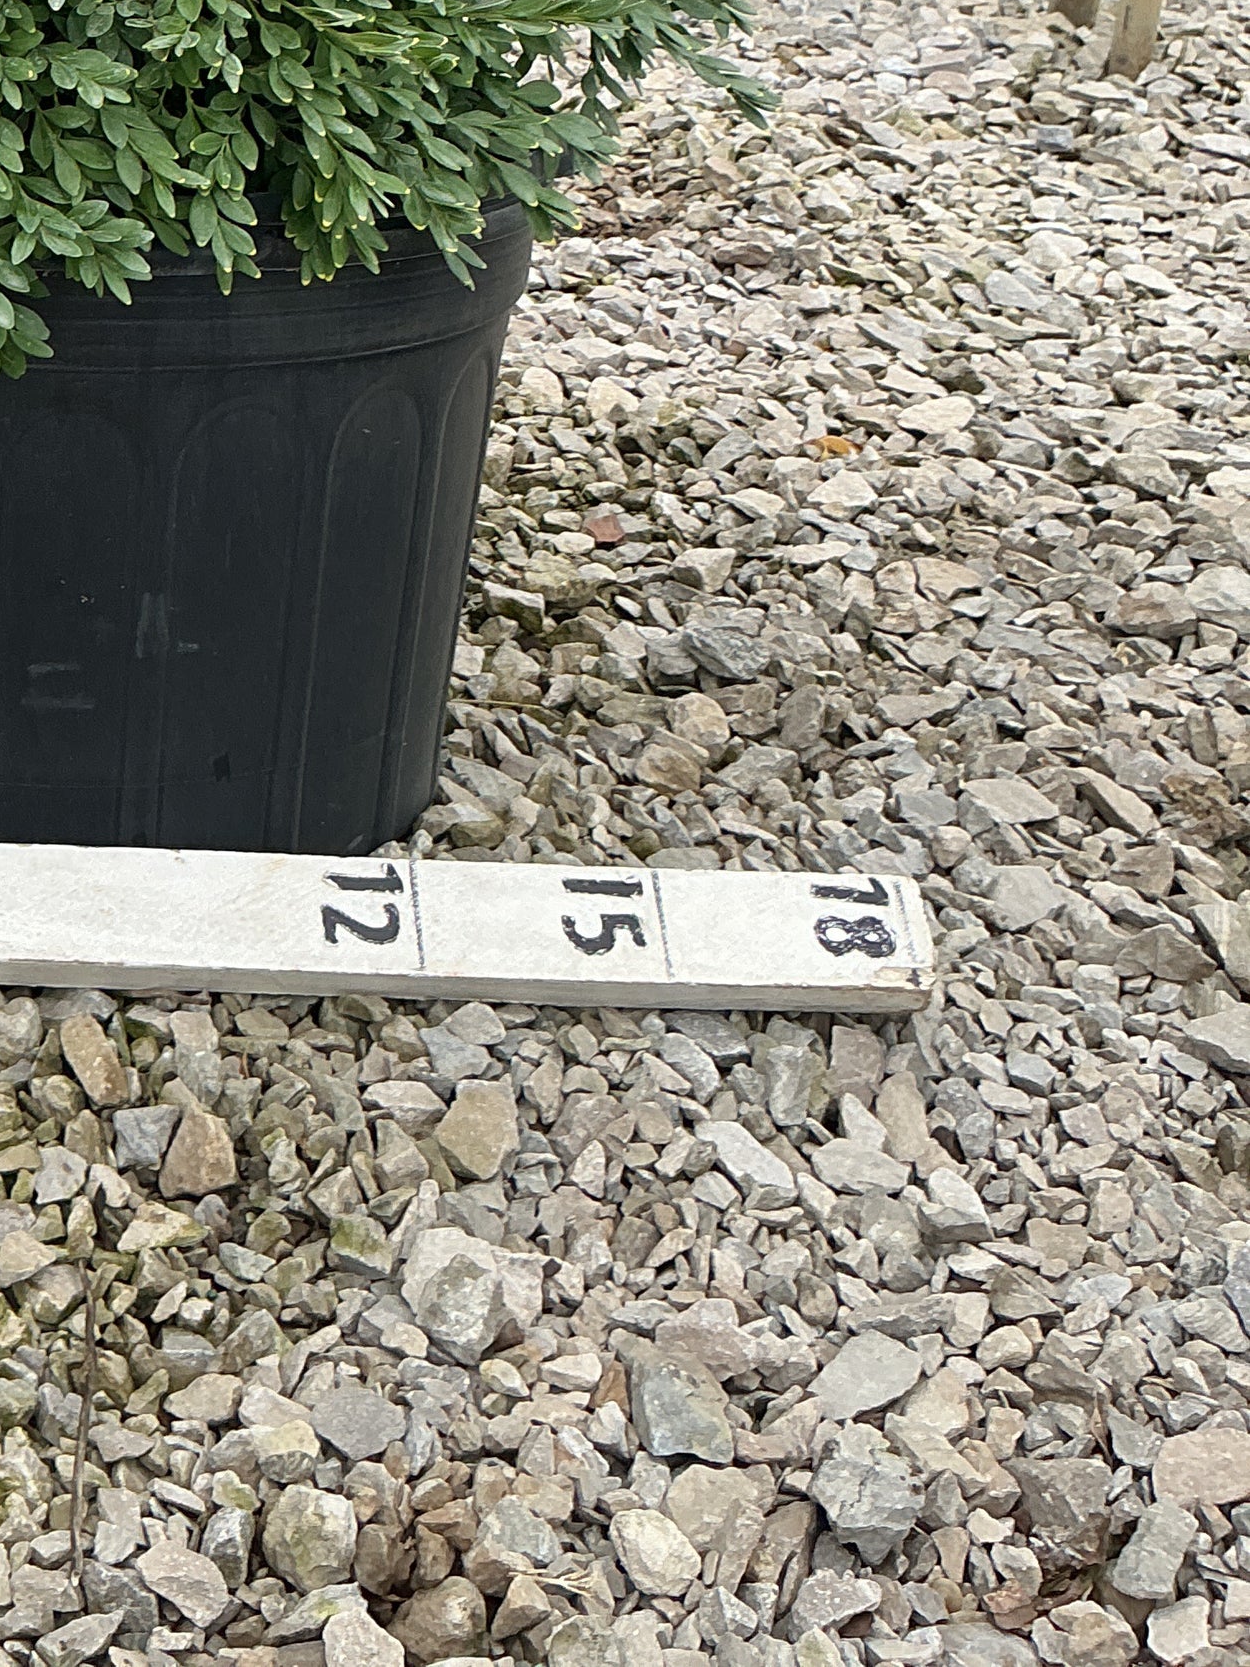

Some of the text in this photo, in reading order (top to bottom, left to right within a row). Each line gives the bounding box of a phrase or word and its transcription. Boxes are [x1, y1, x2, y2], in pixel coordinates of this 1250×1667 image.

[321, 863, 404, 945] 12
[561, 876, 647, 956] 15
[811, 877, 896, 958] 18
